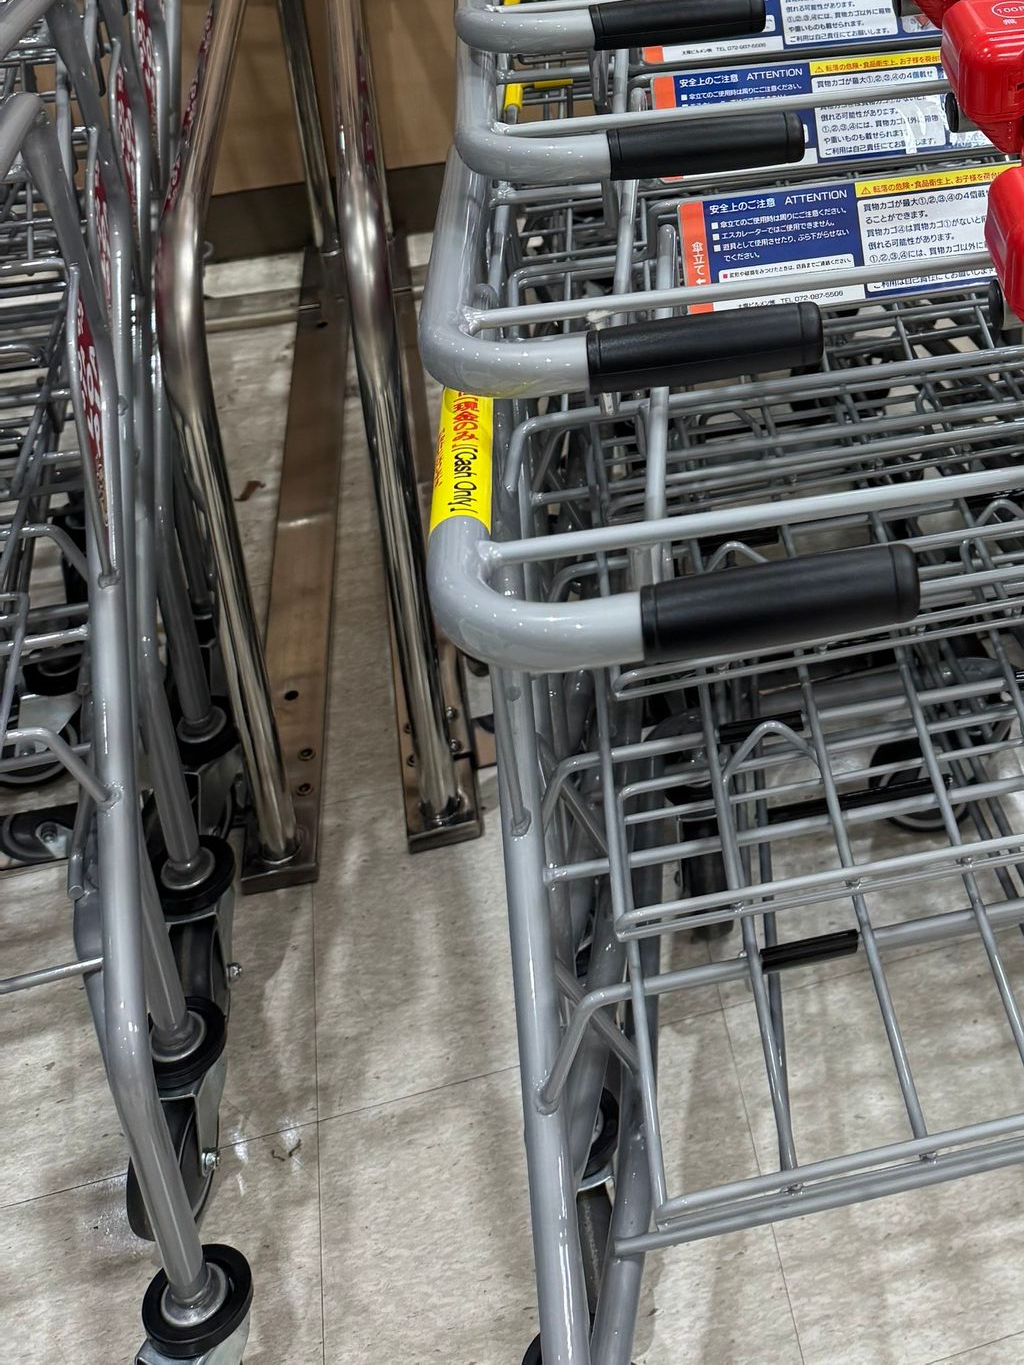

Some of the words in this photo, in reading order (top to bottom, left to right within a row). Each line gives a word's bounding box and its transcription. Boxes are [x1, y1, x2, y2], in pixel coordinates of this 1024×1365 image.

[679, 73, 739, 88] 安全上のご注意
[746, 67, 803, 81] ATTENTION
[709, 197, 776, 216] 安全上のご注意
[784, 189, 848, 206] ATTENTION
[863, 189, 990, 212] 買物カゴが最大①,②,③,④の4個載
[865, 209, 929, 225] ることができます。
[720, 220, 836, 240] エスカレーターではご使用できません。
[867, 234, 956, 252] 倒れる可能性があります。
[692, 242, 705, 276] 傘立て
[723, 251, 761, 262] でください。
